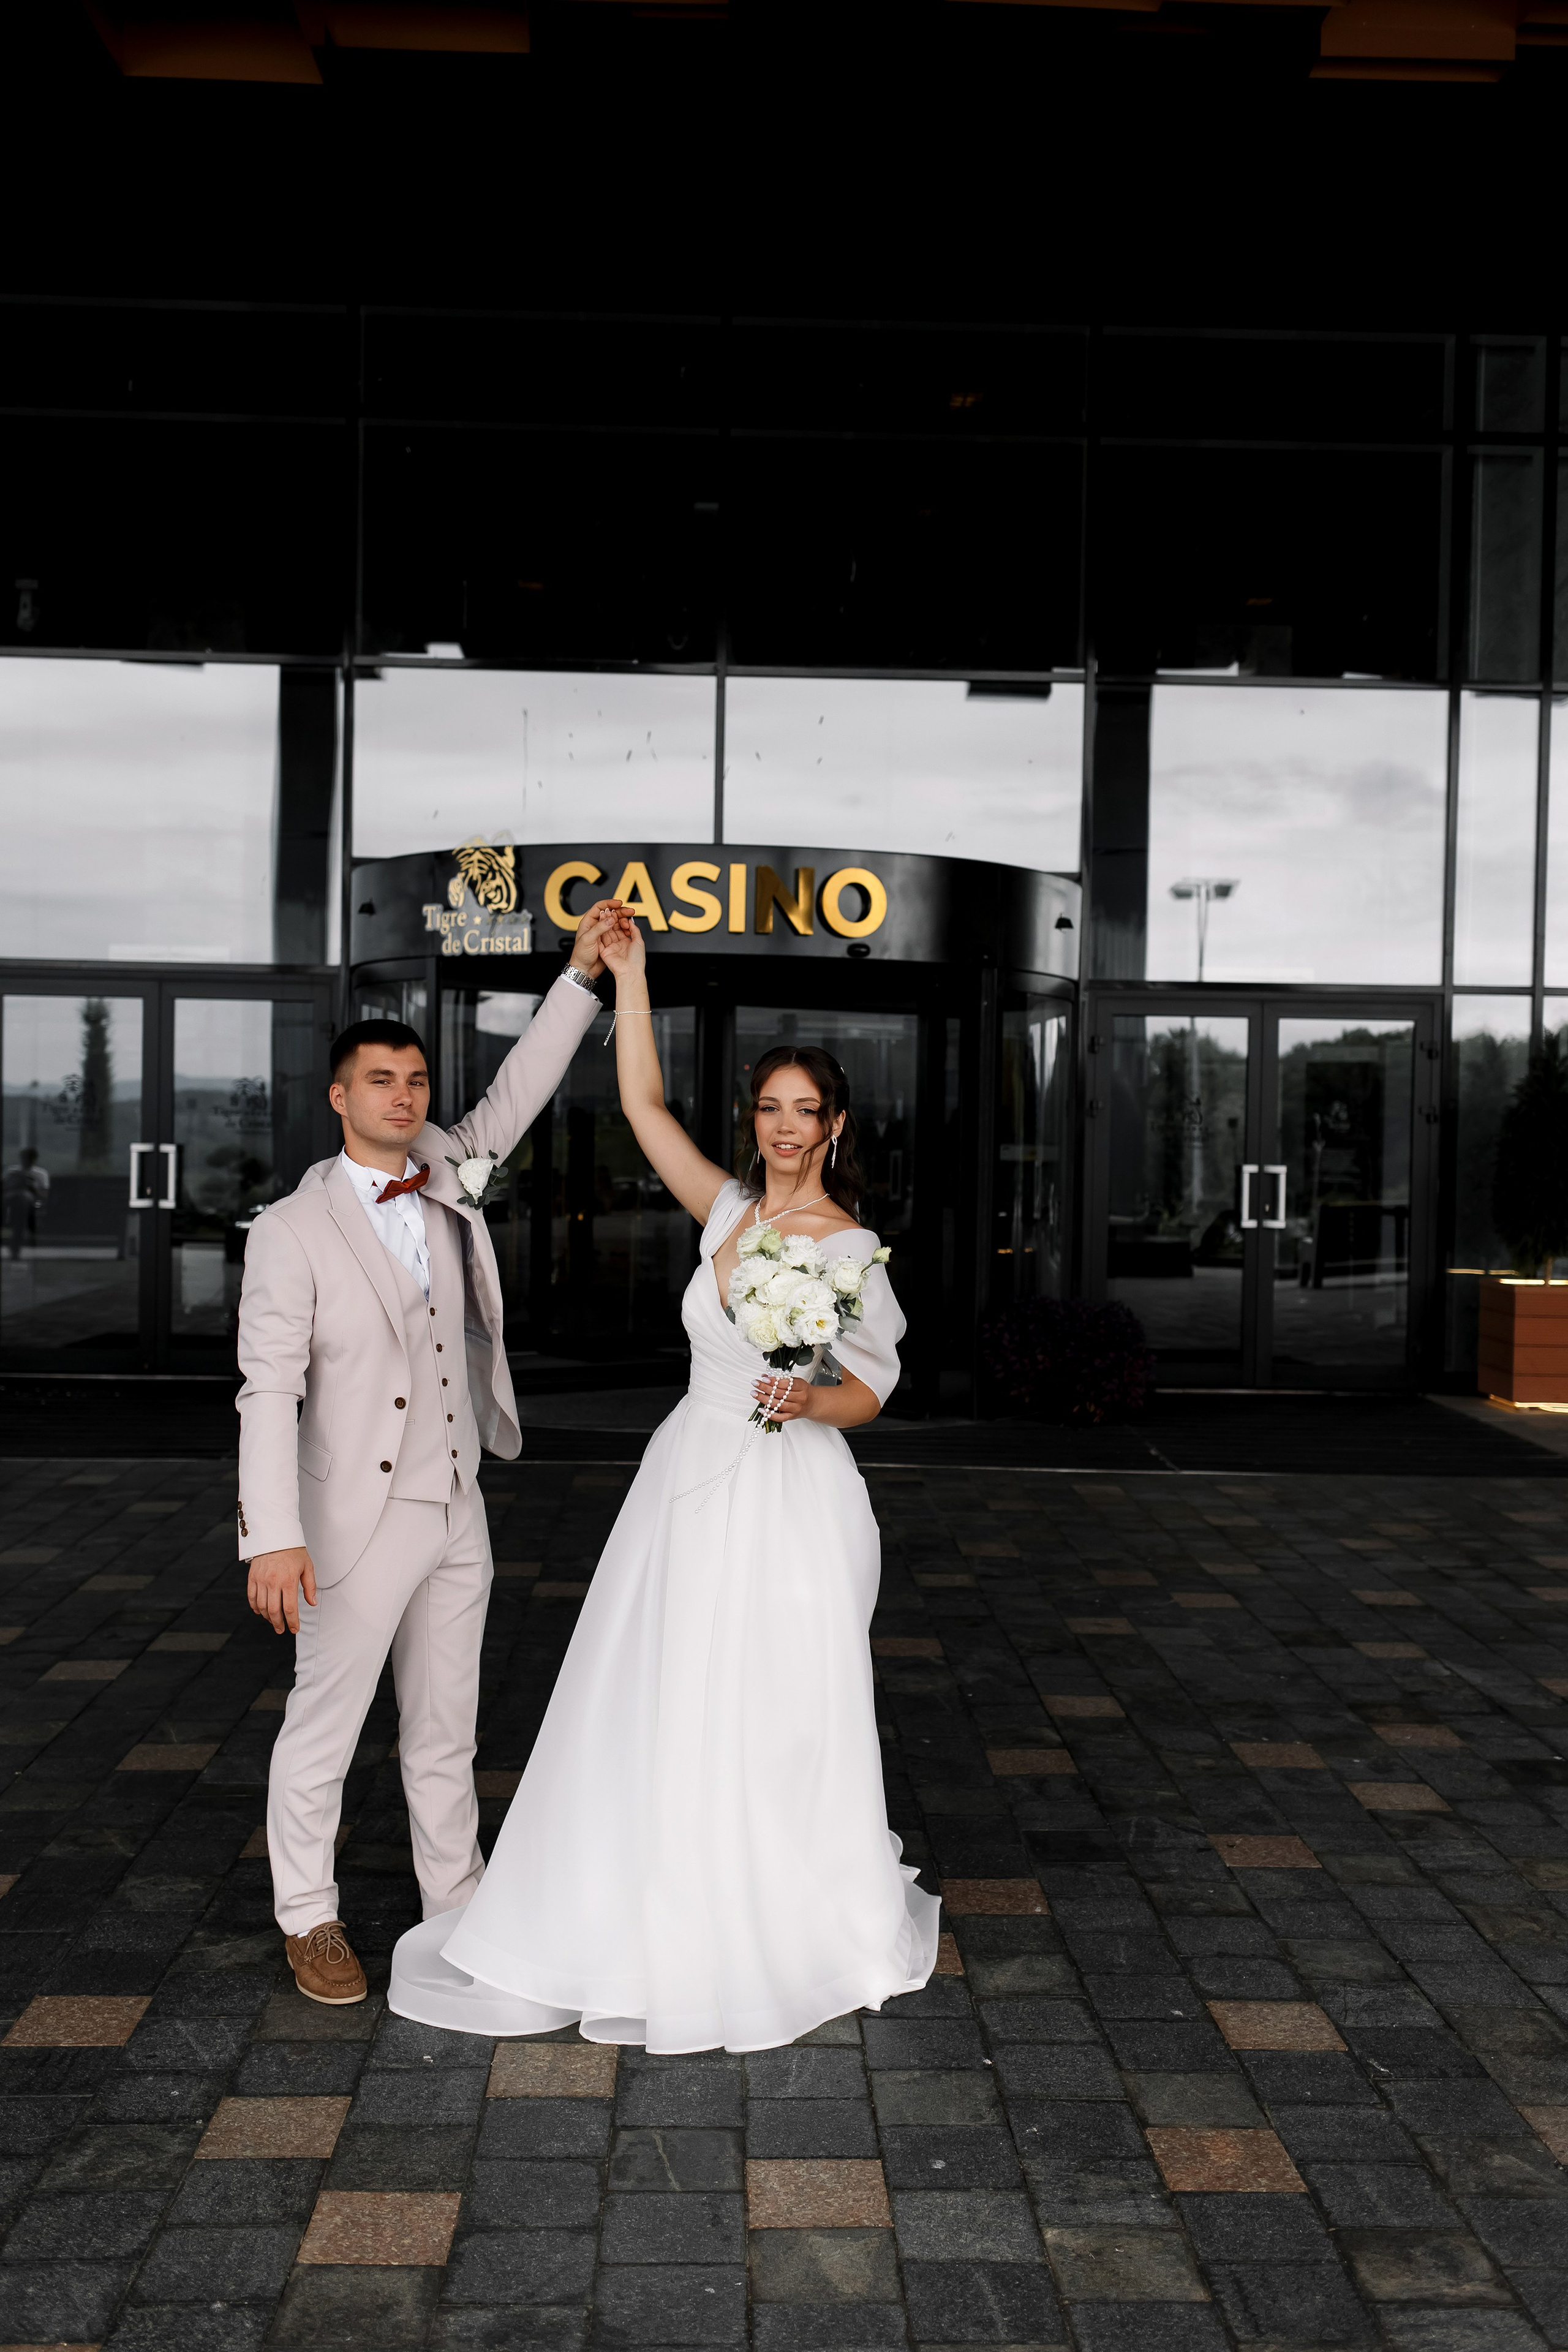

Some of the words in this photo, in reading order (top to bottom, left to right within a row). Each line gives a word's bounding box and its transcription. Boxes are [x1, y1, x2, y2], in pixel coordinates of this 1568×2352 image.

[543, 861, 888, 938] CASINO
[422, 905, 467, 935] Tigre
[442, 932, 461, 954] de
[463, 927, 529, 954] Cristal
